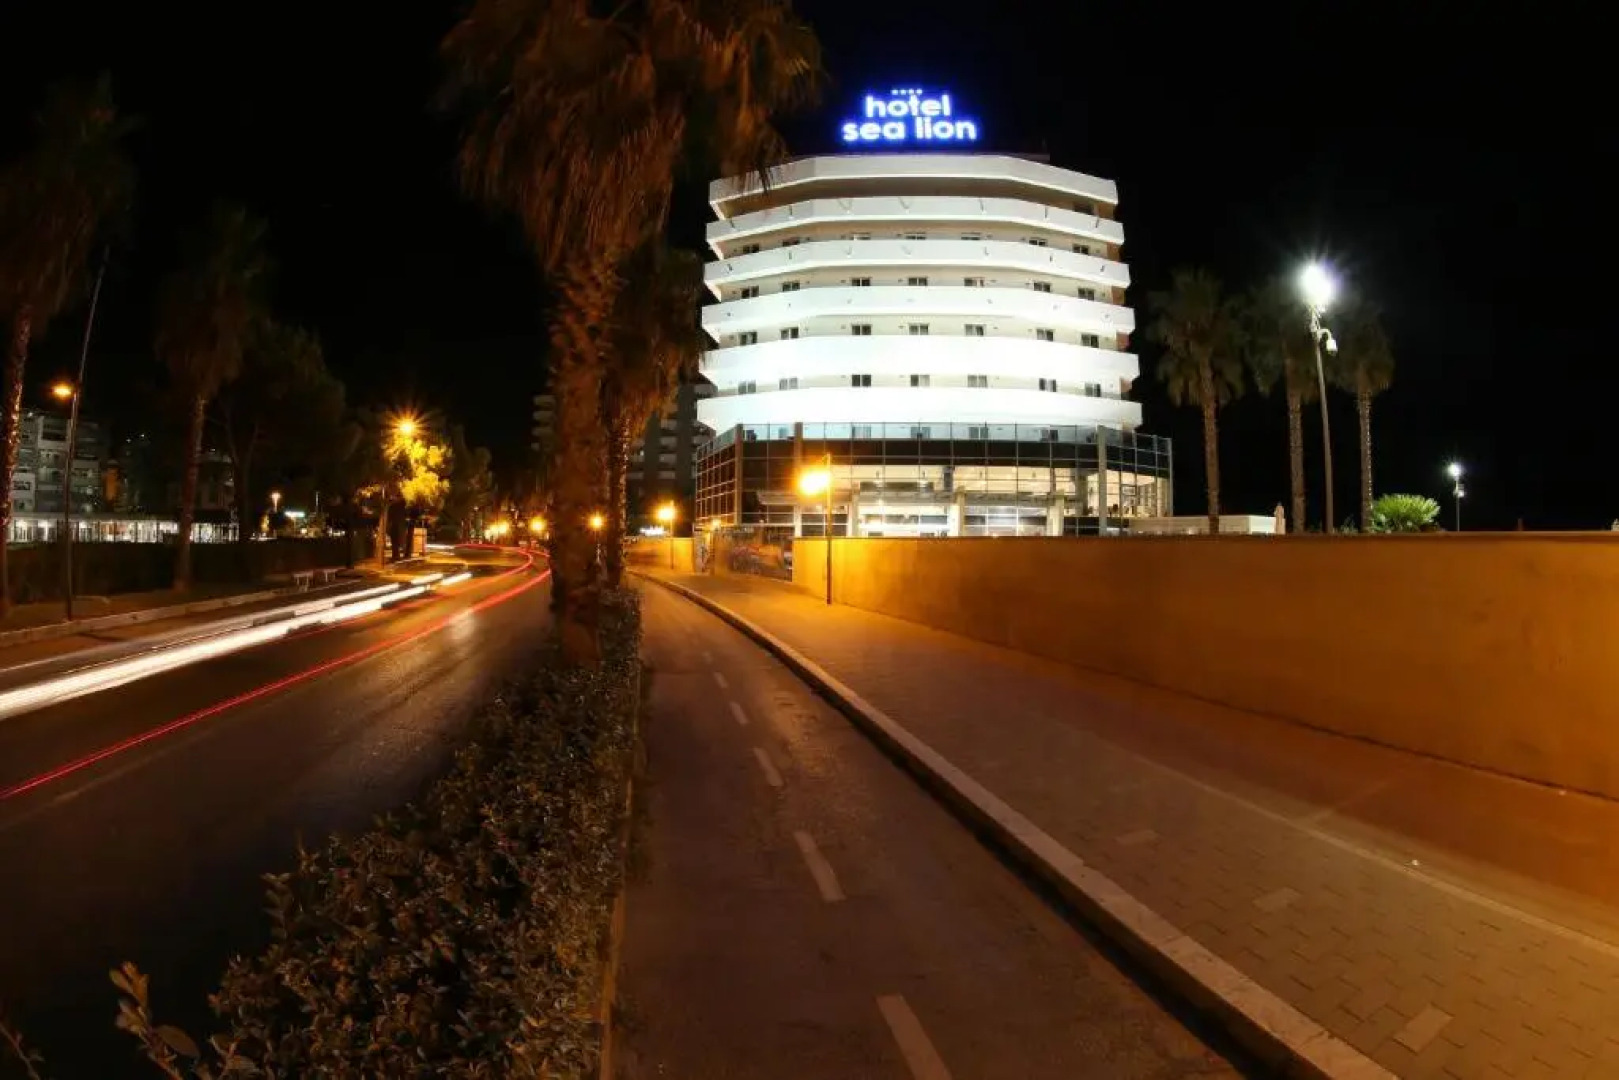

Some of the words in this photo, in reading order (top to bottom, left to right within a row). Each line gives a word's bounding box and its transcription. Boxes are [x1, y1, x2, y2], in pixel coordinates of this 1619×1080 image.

[865, 94, 951, 118] hotel
[843, 121, 905, 141] sea
[915, 116, 977, 140] lion
